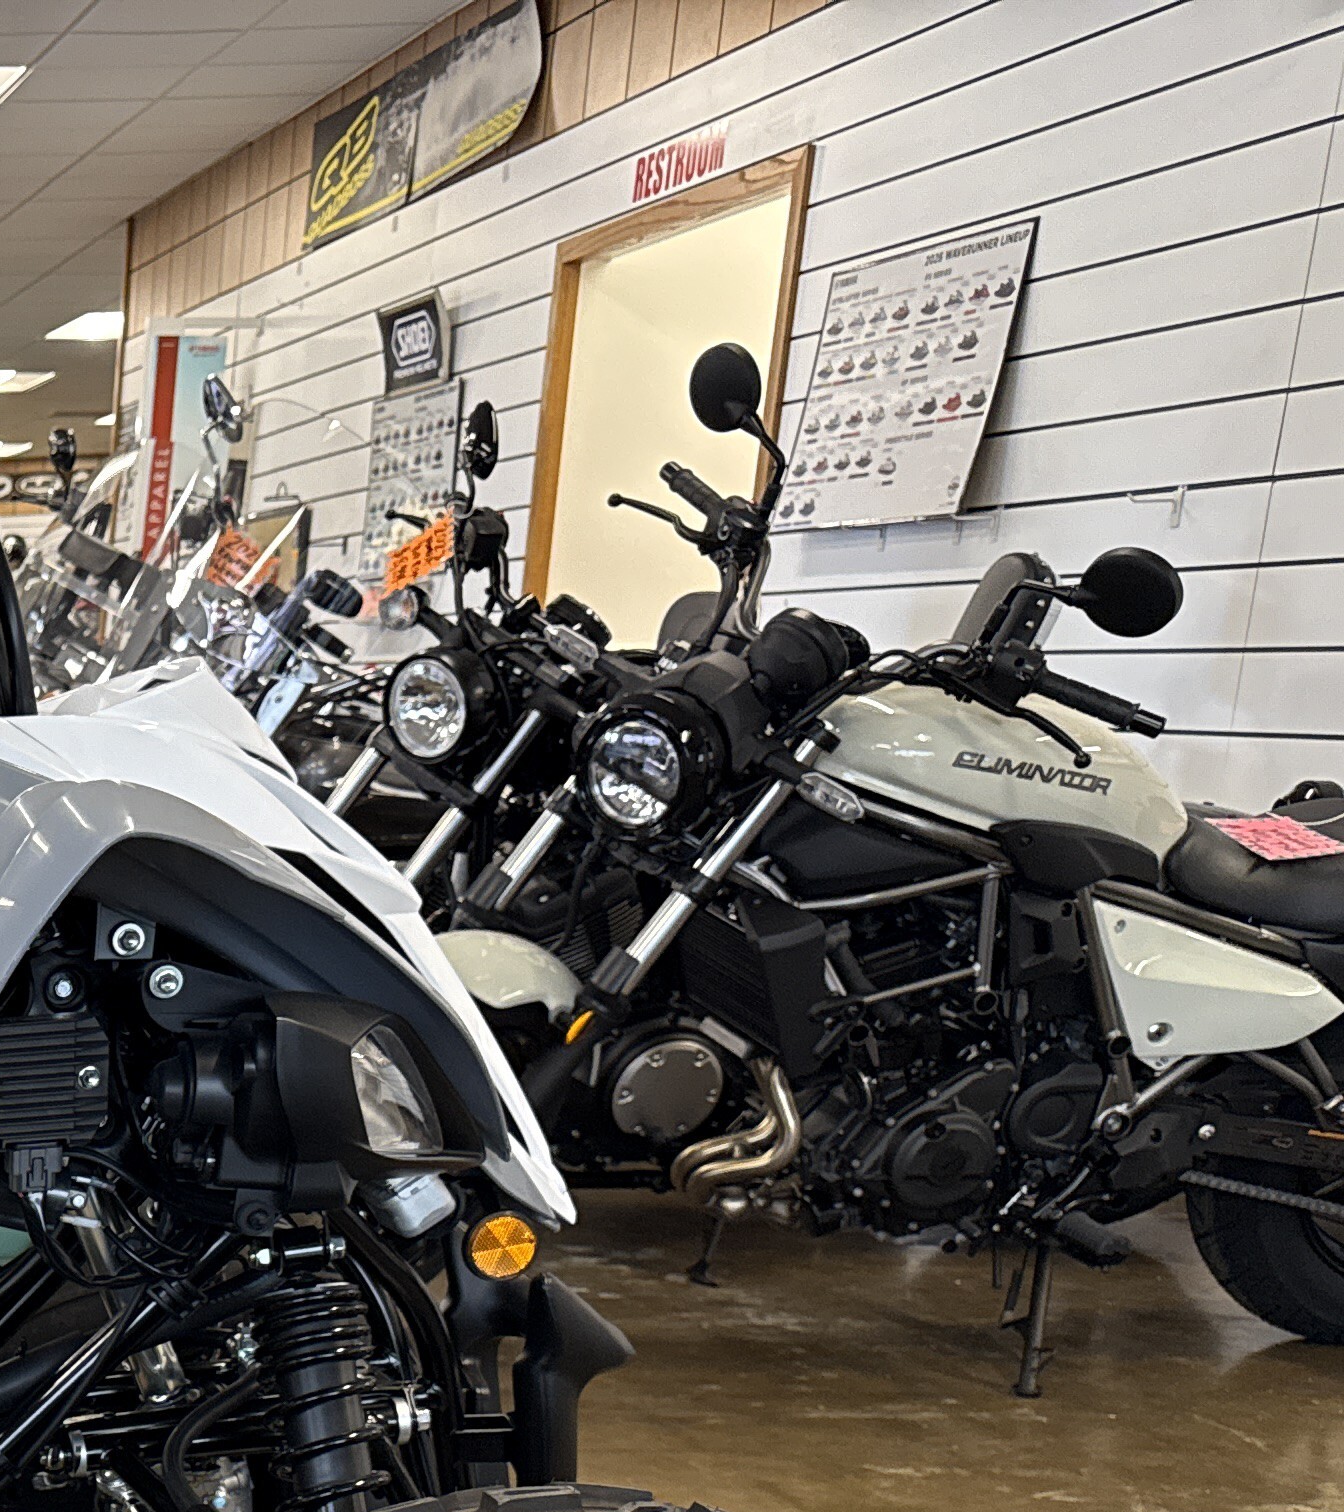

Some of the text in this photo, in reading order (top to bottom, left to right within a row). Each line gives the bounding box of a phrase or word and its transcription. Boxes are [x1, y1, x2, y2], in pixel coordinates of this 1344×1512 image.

[632, 130, 728, 203] RESTROOM
[397, 320, 430, 358] SHOEI
[147, 447, 170, 539] APPAREL
[952, 751, 1112, 796] ELIMINATOR
